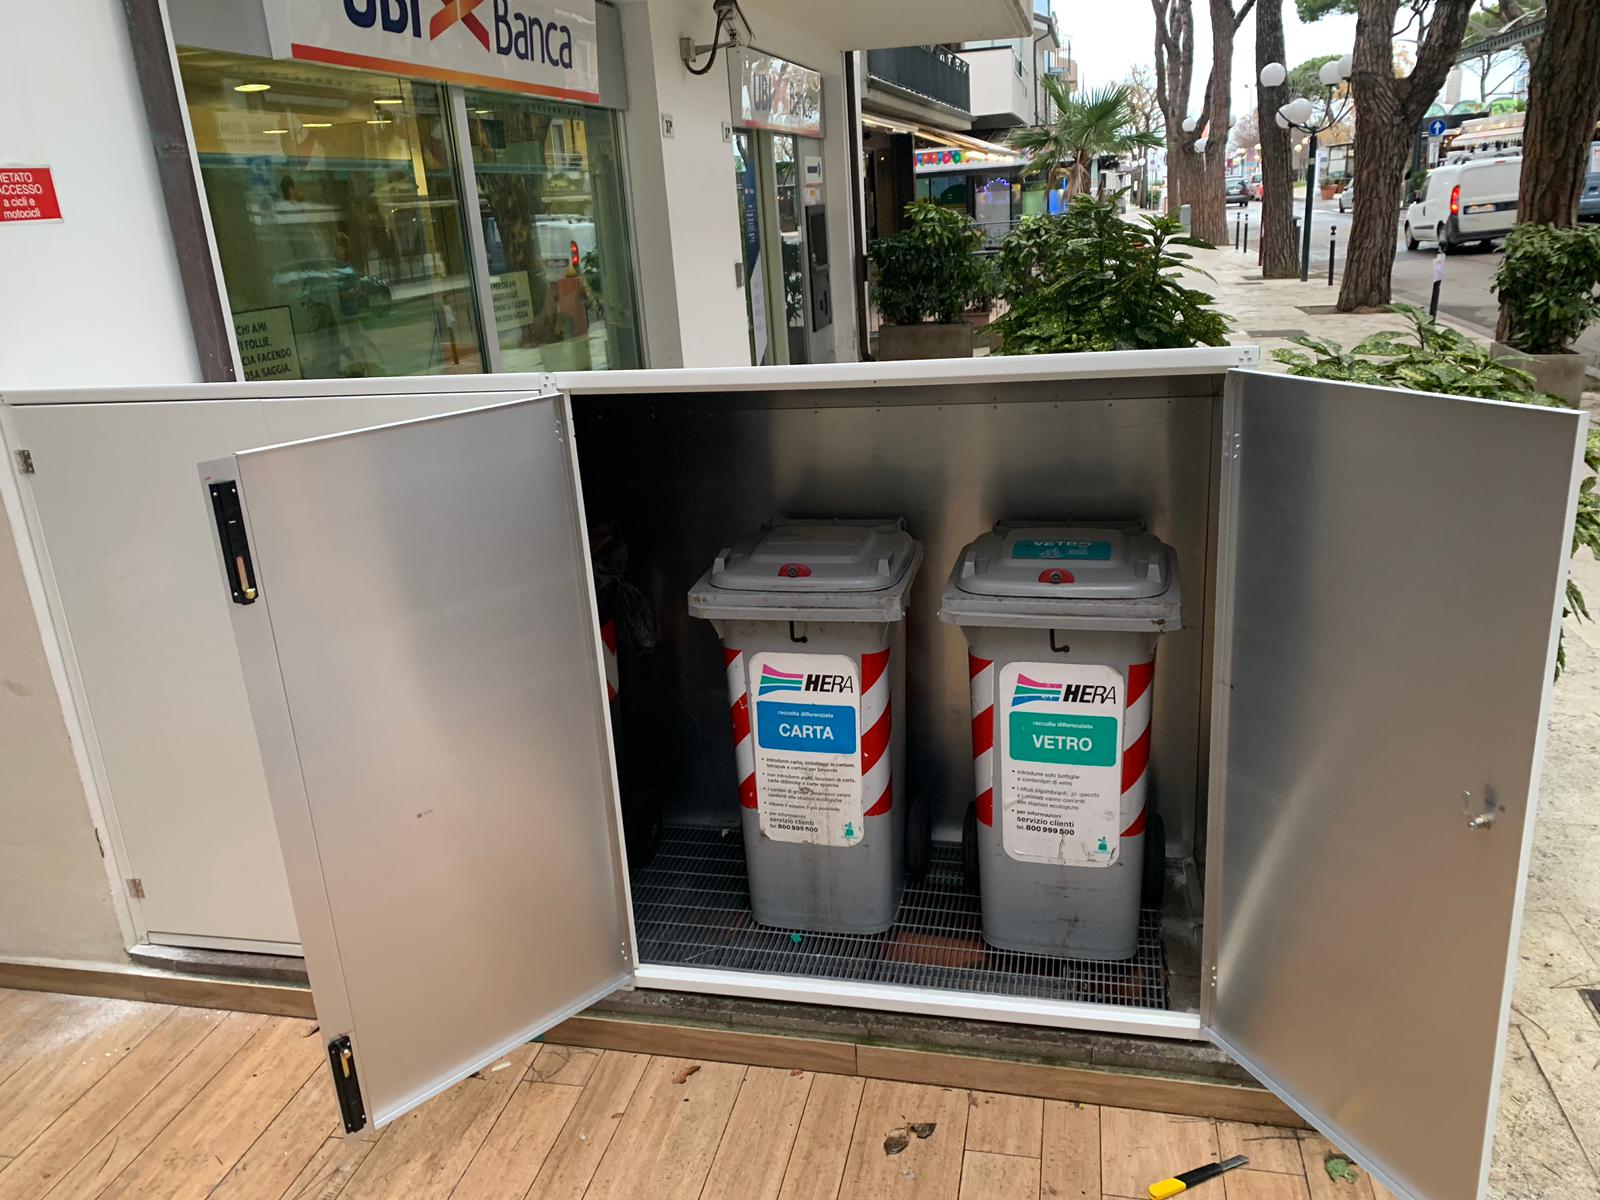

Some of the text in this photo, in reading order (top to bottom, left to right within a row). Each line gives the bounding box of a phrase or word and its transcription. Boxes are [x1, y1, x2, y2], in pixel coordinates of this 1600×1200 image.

[494, 0, 572, 69] Banca
[4, 196, 35, 207] a cicli e
[4, 208, 41, 219] motocicli
[252, 322, 267, 333] AMI
[257, 347, 292, 362] FACENDO
[804, 674, 854, 693] HERA
[1062, 684, 1116, 704] HERA
[800, 711, 834, 719] differenziata
[778, 723, 835, 740] CARTA
[1032, 734, 1093, 752] VETRO
[1027, 810, 1061, 818] informazioni
[769, 817, 815, 826] servizio clienti
[1016, 816, 1075, 828] servizio clienti
[1025, 824, 1041, 832] 800
[1042, 826, 1058, 834] 999
